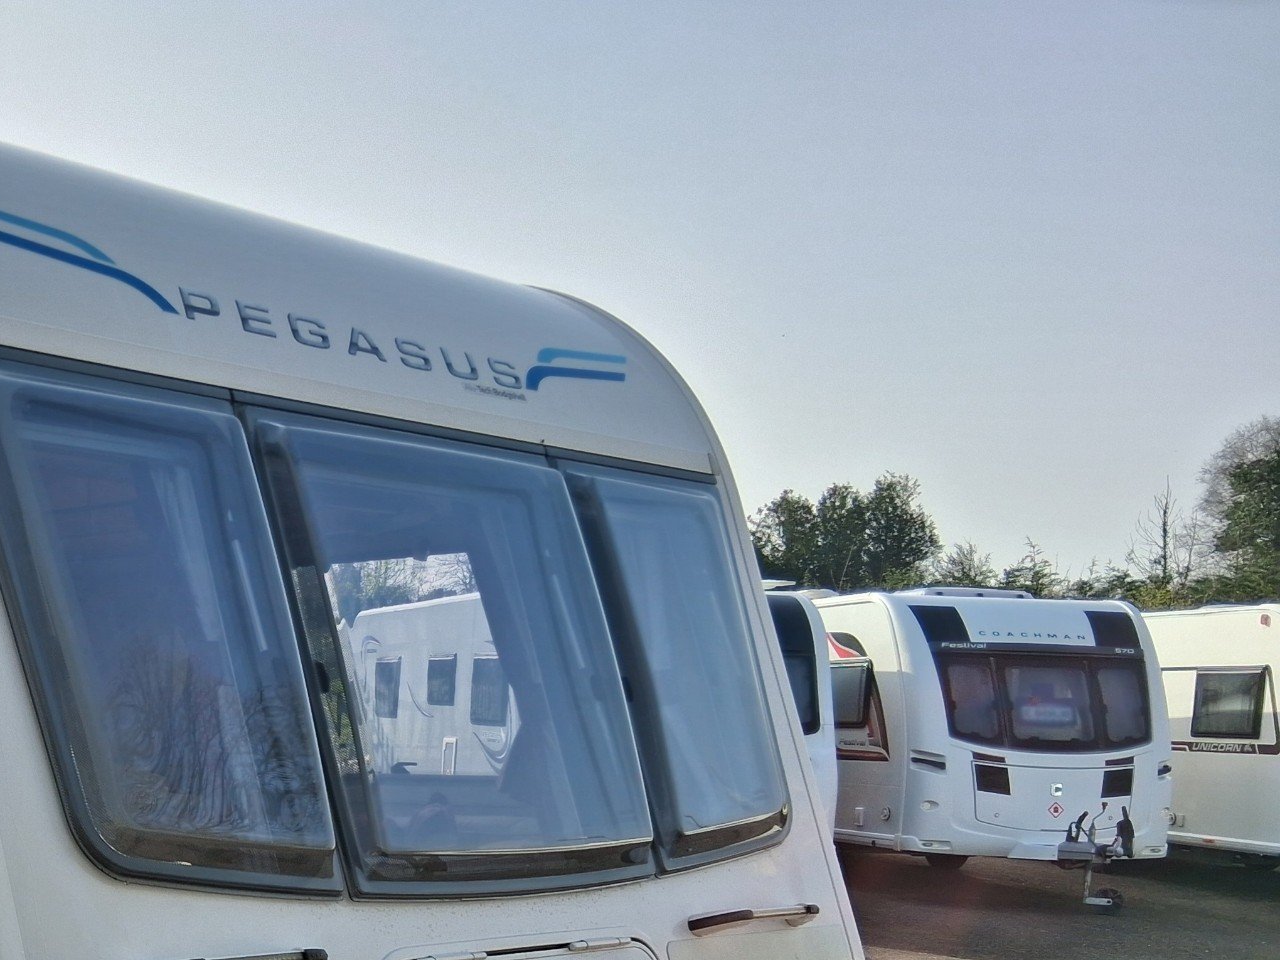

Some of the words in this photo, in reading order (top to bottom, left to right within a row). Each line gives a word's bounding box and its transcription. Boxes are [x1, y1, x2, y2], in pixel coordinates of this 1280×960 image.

[178, 286, 523, 390] PEGASUS
[978, 630, 1086, 640] COACHMAN
[941, 641, 987, 649] Festival
[1192, 742, 1242, 752] UNICORN
